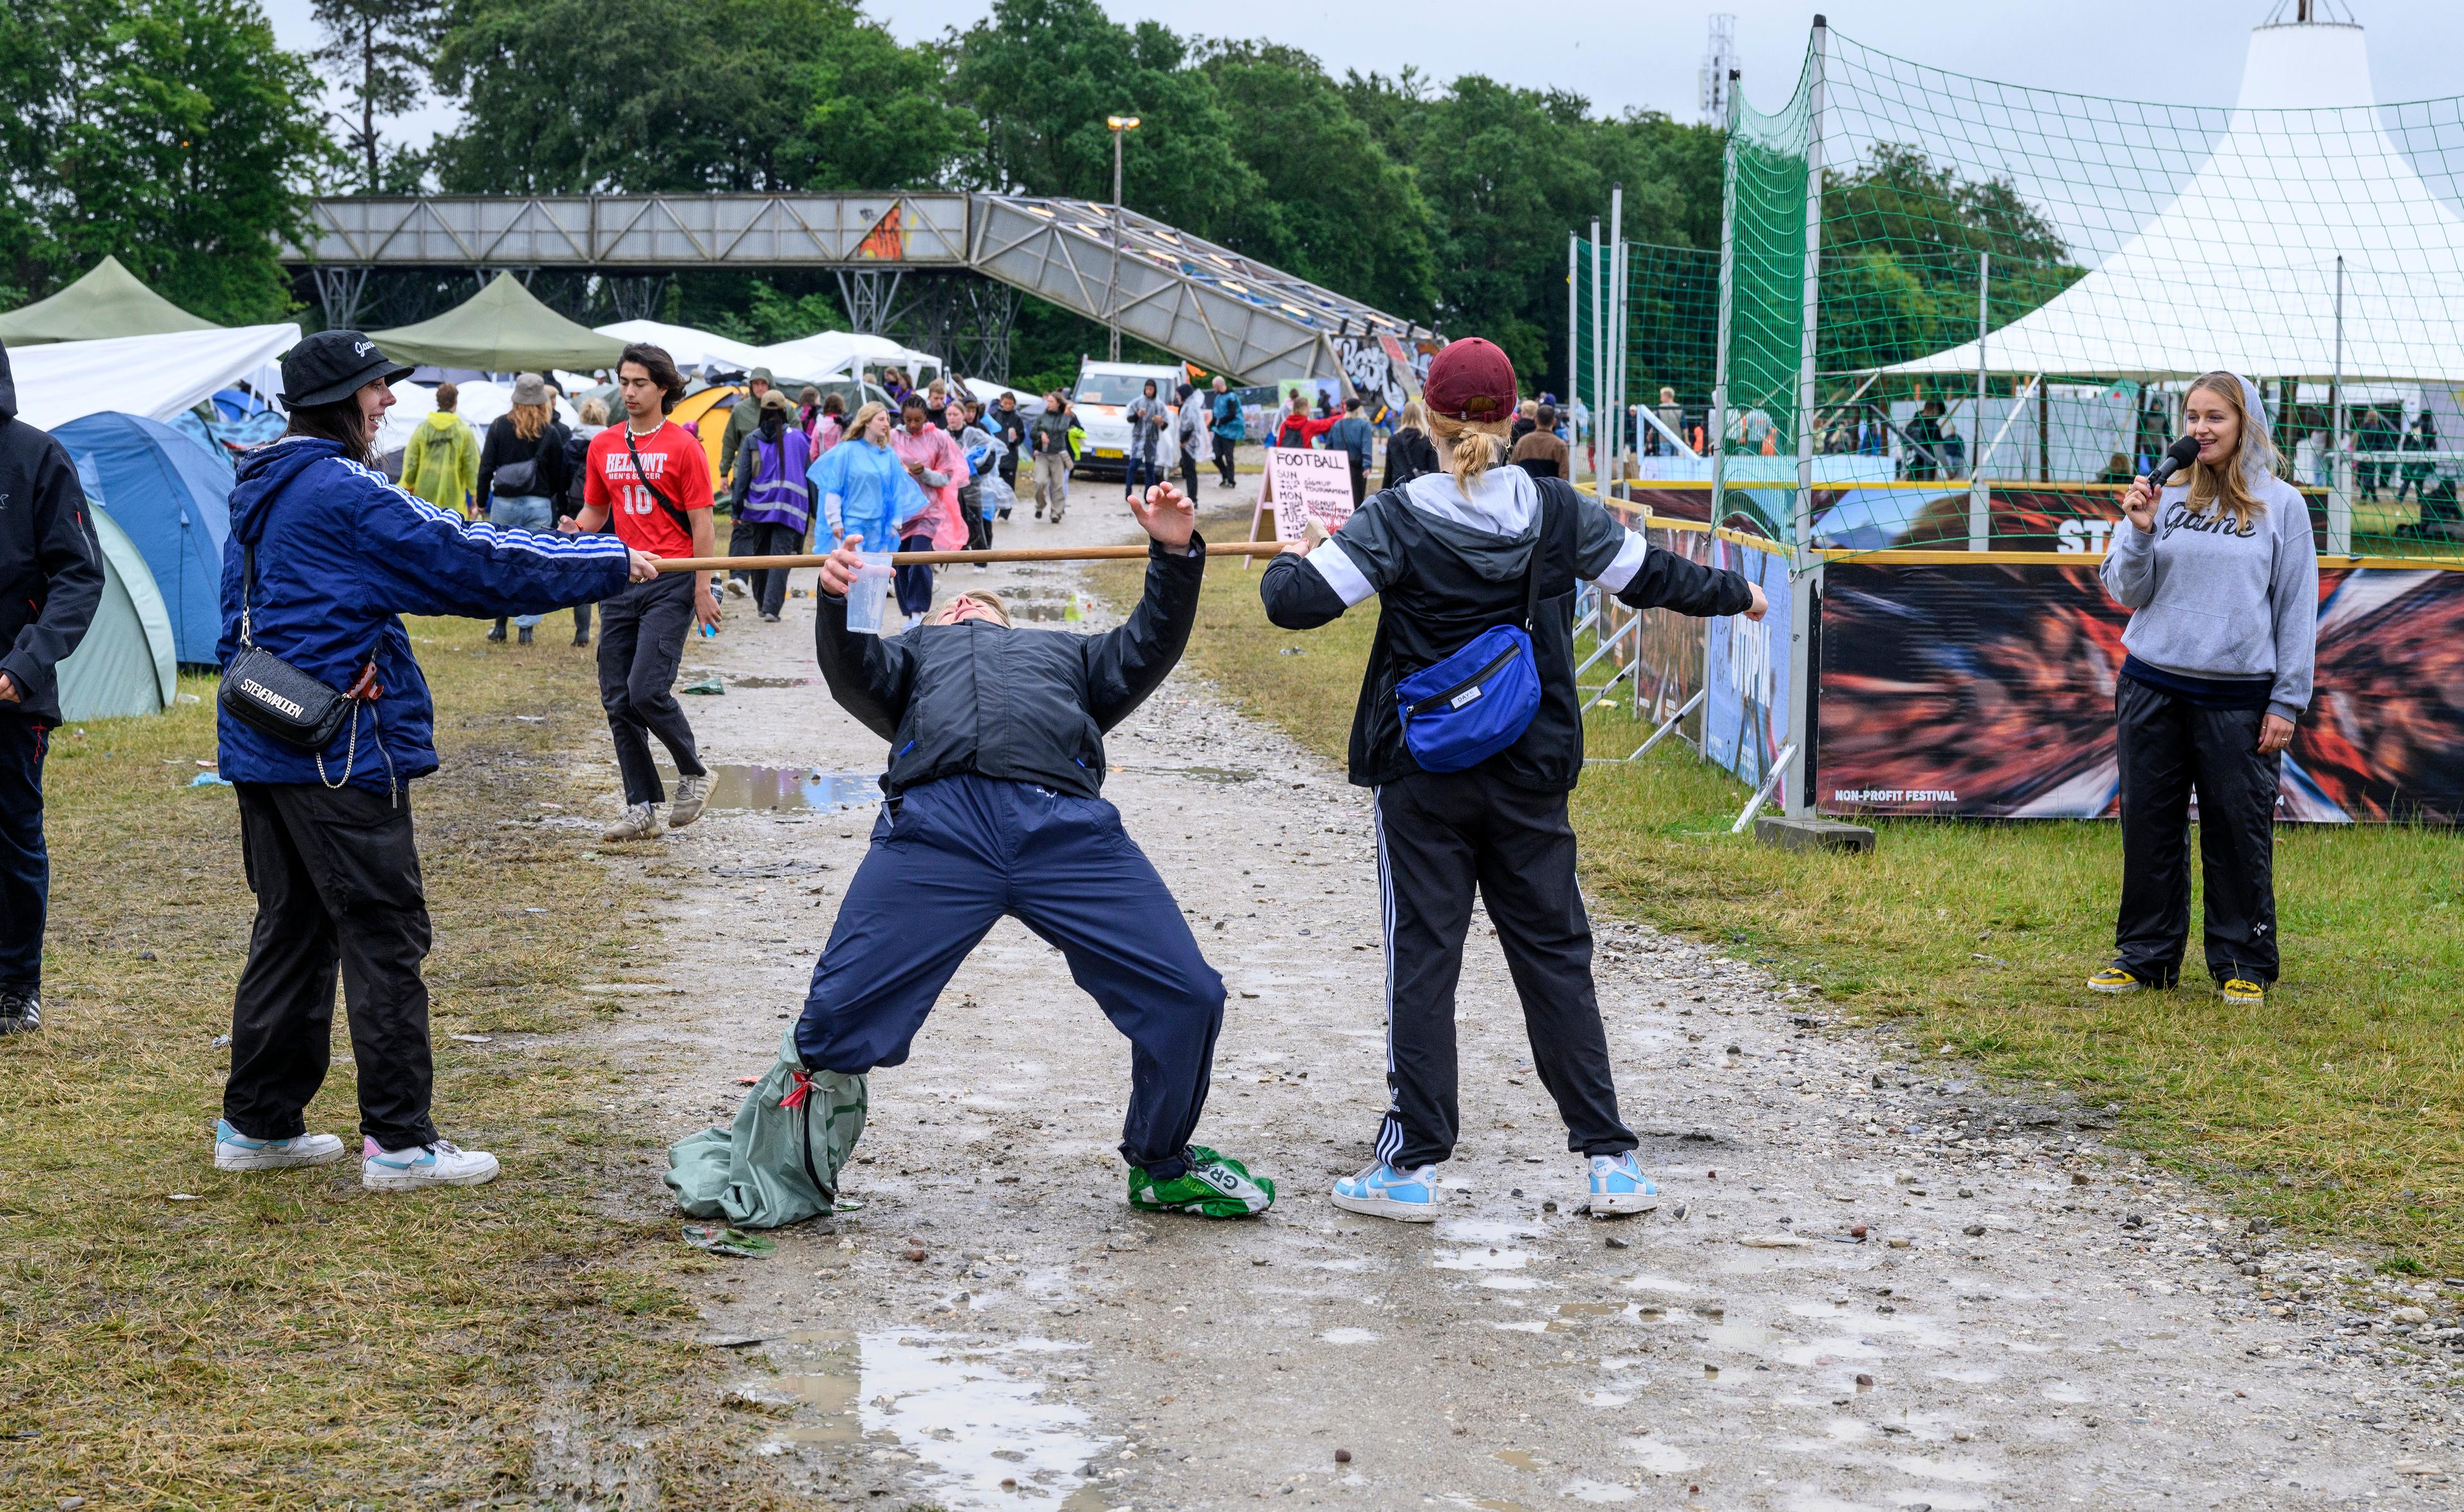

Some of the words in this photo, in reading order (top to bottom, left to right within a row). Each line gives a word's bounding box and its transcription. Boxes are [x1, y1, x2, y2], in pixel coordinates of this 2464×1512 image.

[1276, 453, 1344, 470] FOOTBALL
[1276, 470, 1297, 479] SUN
[622, 484, 653, 515] 10
[1279, 491, 1303, 503] MON
[1280, 514, 1308, 523] TUES
[1731, 611, 1770, 708] UTOPIA
[1457, 693, 1470, 702] DAY
[1835, 790, 1904, 801] NON-PROFIT
[1905, 790, 1958, 801] FESTIVAL
